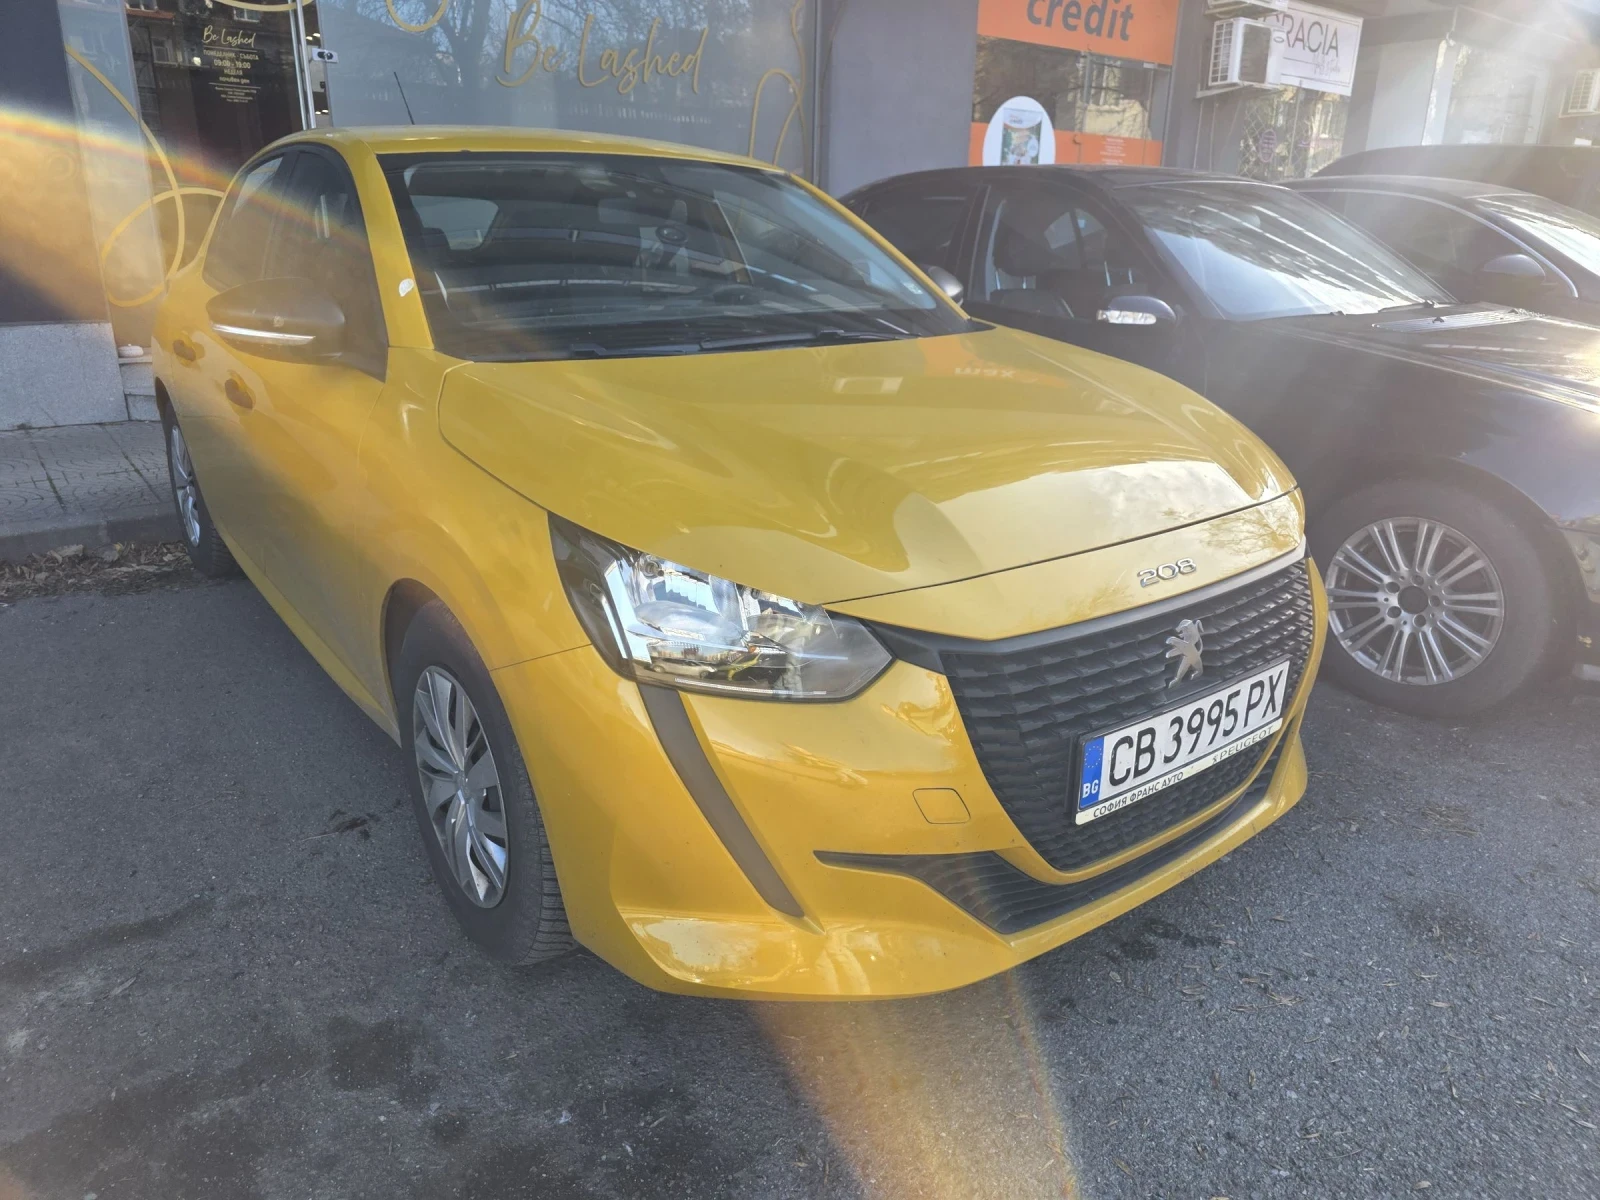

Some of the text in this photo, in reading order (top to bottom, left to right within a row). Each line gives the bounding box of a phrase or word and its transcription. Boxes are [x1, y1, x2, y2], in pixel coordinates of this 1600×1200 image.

[201, 25, 256, 48] Be Lashed
[1026, 0, 1134, 42] credit
[495, 0, 710, 96] Be Lashed
[1137, 557, 1196, 588] 208
[1108, 669, 1283, 787] CB 3995 PX
[1219, 727, 1274, 761] PEUGEOT
[1082, 779, 1099, 799] BG
[1093, 771, 1184, 819] СОФИЯ ФРАНС АУТО
